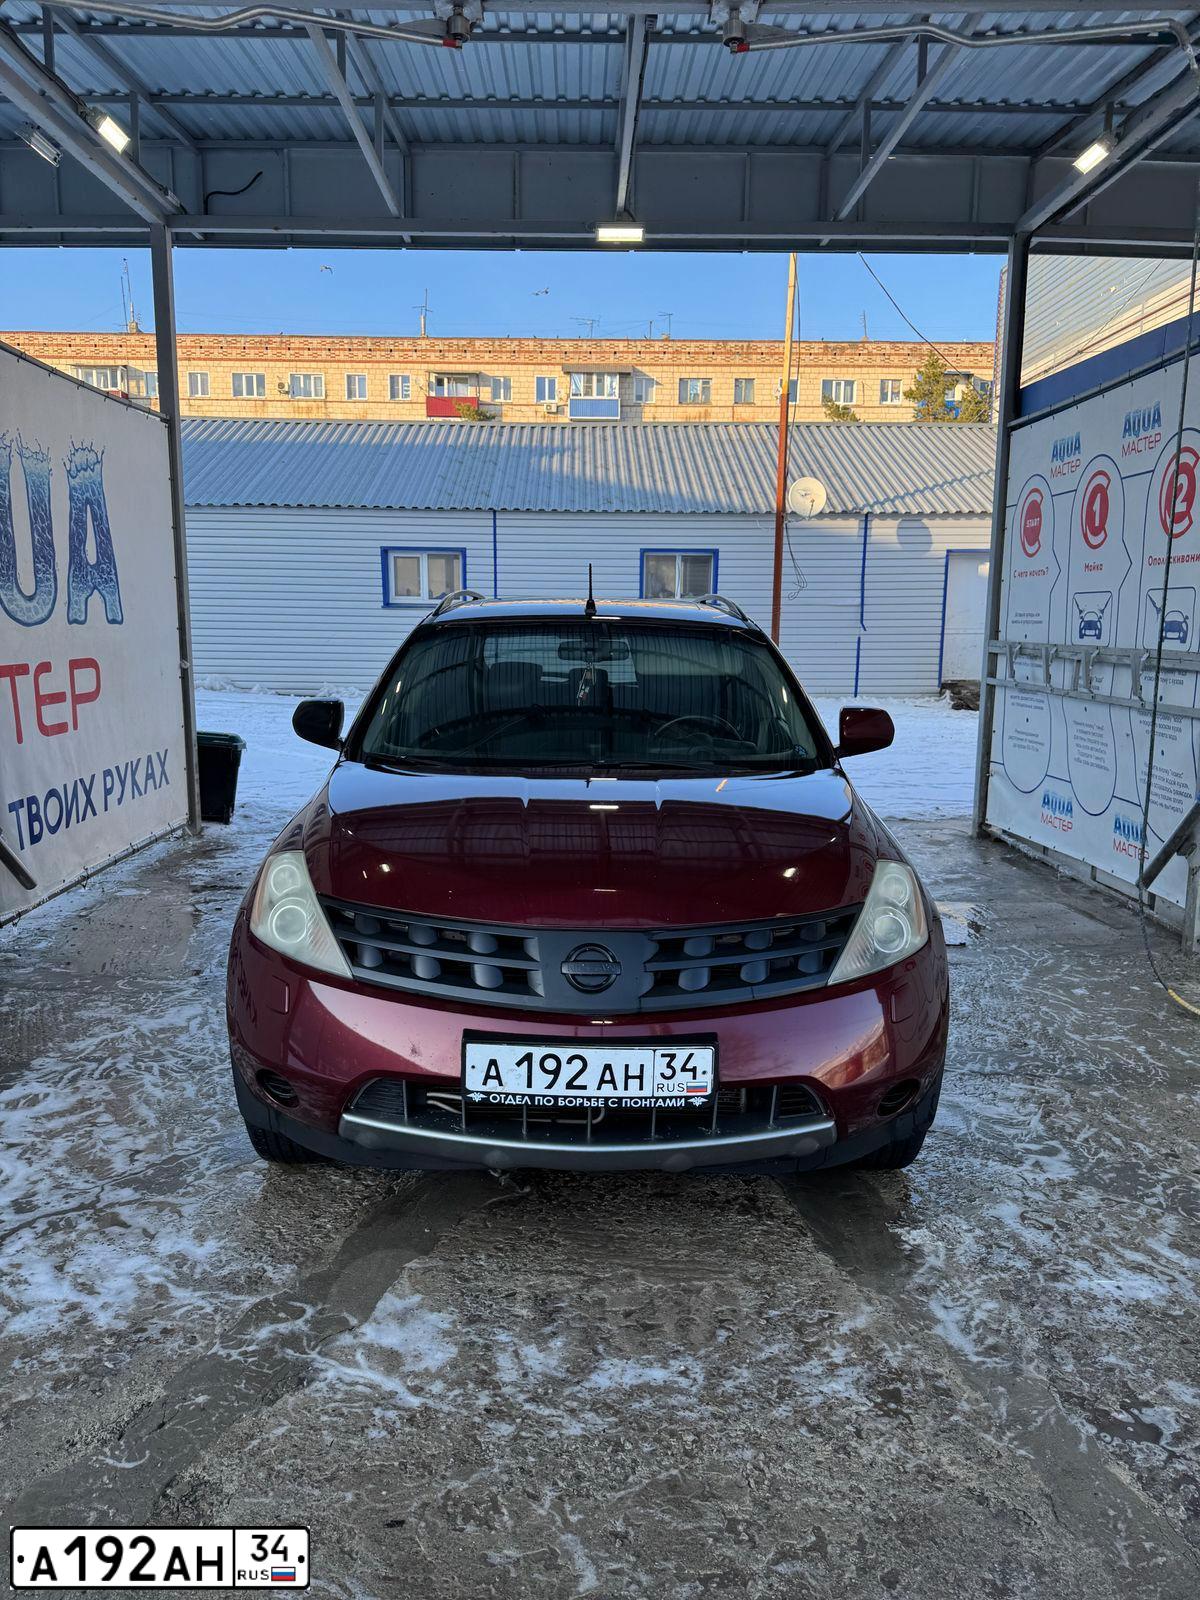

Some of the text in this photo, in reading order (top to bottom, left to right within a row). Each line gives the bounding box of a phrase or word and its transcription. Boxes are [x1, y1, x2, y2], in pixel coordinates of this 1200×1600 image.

[1122, 401, 1162, 438] AQUA
[1051, 431, 1082, 463] AQUA
[1121, 432, 1162, 458] МАСТЕР
[1050, 458, 1081, 479] МАСТЕР
[1026, 517, 1040, 528] START
[1093, 492, 1101, 527] 1
[1084, 562, 1103, 573] Мойка
[8, 748, 170, 851] ТВОИХ РУКАХ
[1041, 789, 1073, 818] AQUA
[1041, 811, 1073, 832] МАСТЕР
[660, 1053, 697, 1080] 34
[489, 1093, 685, 1108] ОТДЕЛ ПО БОРЬБЕ С ПОНТАМИ
[656, 1083, 684, 1093] RUS
